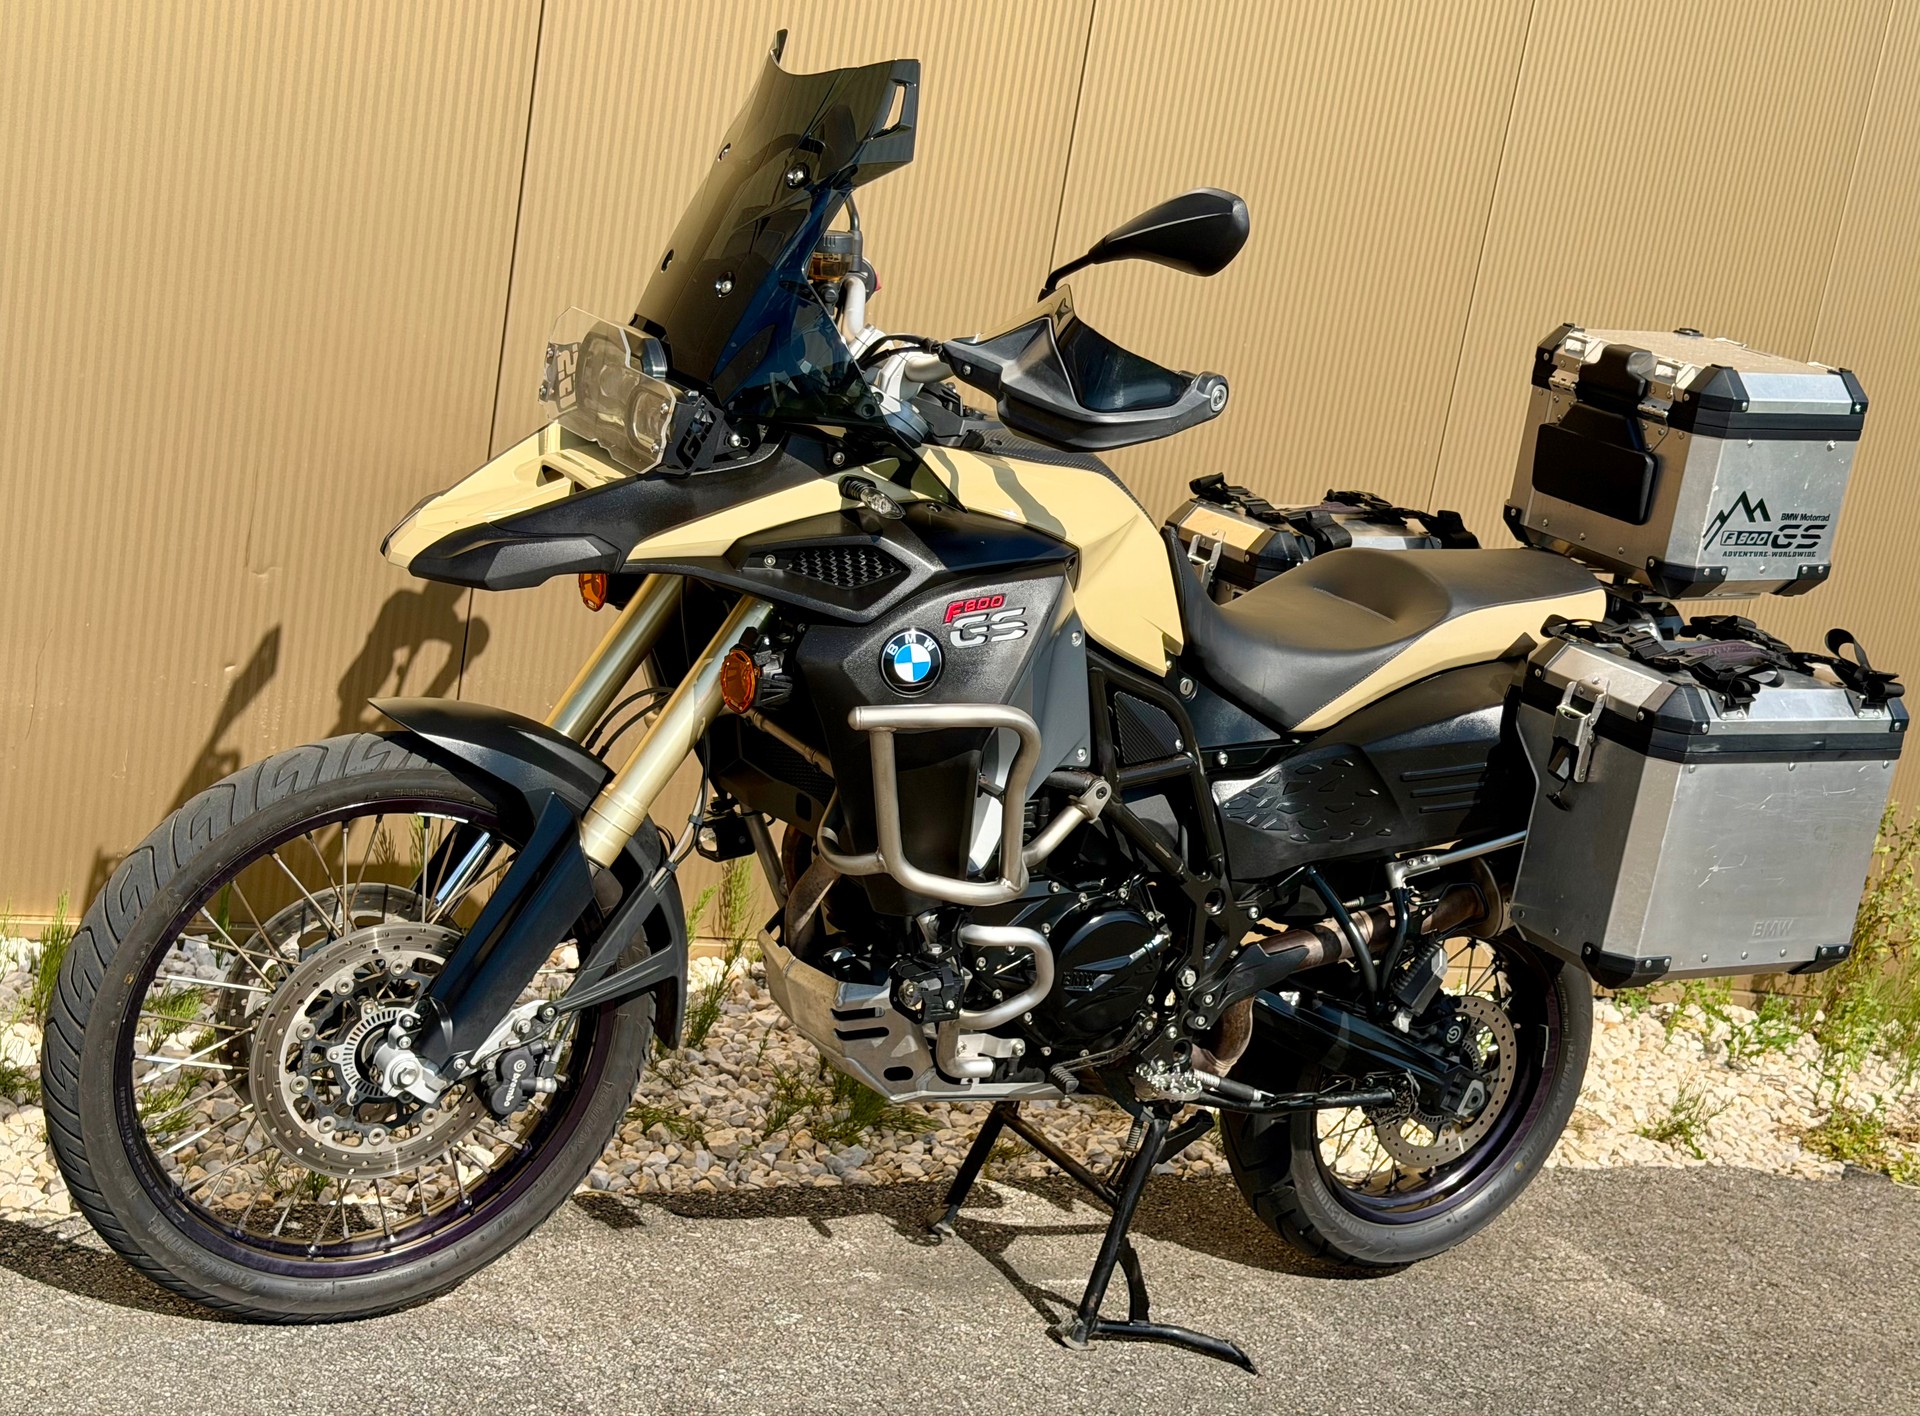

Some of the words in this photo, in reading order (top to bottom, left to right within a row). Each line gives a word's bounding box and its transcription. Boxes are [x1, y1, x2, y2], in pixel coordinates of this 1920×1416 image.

[1780, 512, 1799, 521] BMW
[1799, 513, 1831, 522] Motorrad
[1770, 524, 1828, 549] GS
[944, 594, 1005, 623] F800
[950, 607, 1028, 648] GS
[886, 633, 936, 656] BMW
[1751, 918, 1794, 937] BMW
[503, 1072, 521, 1107] brembo
